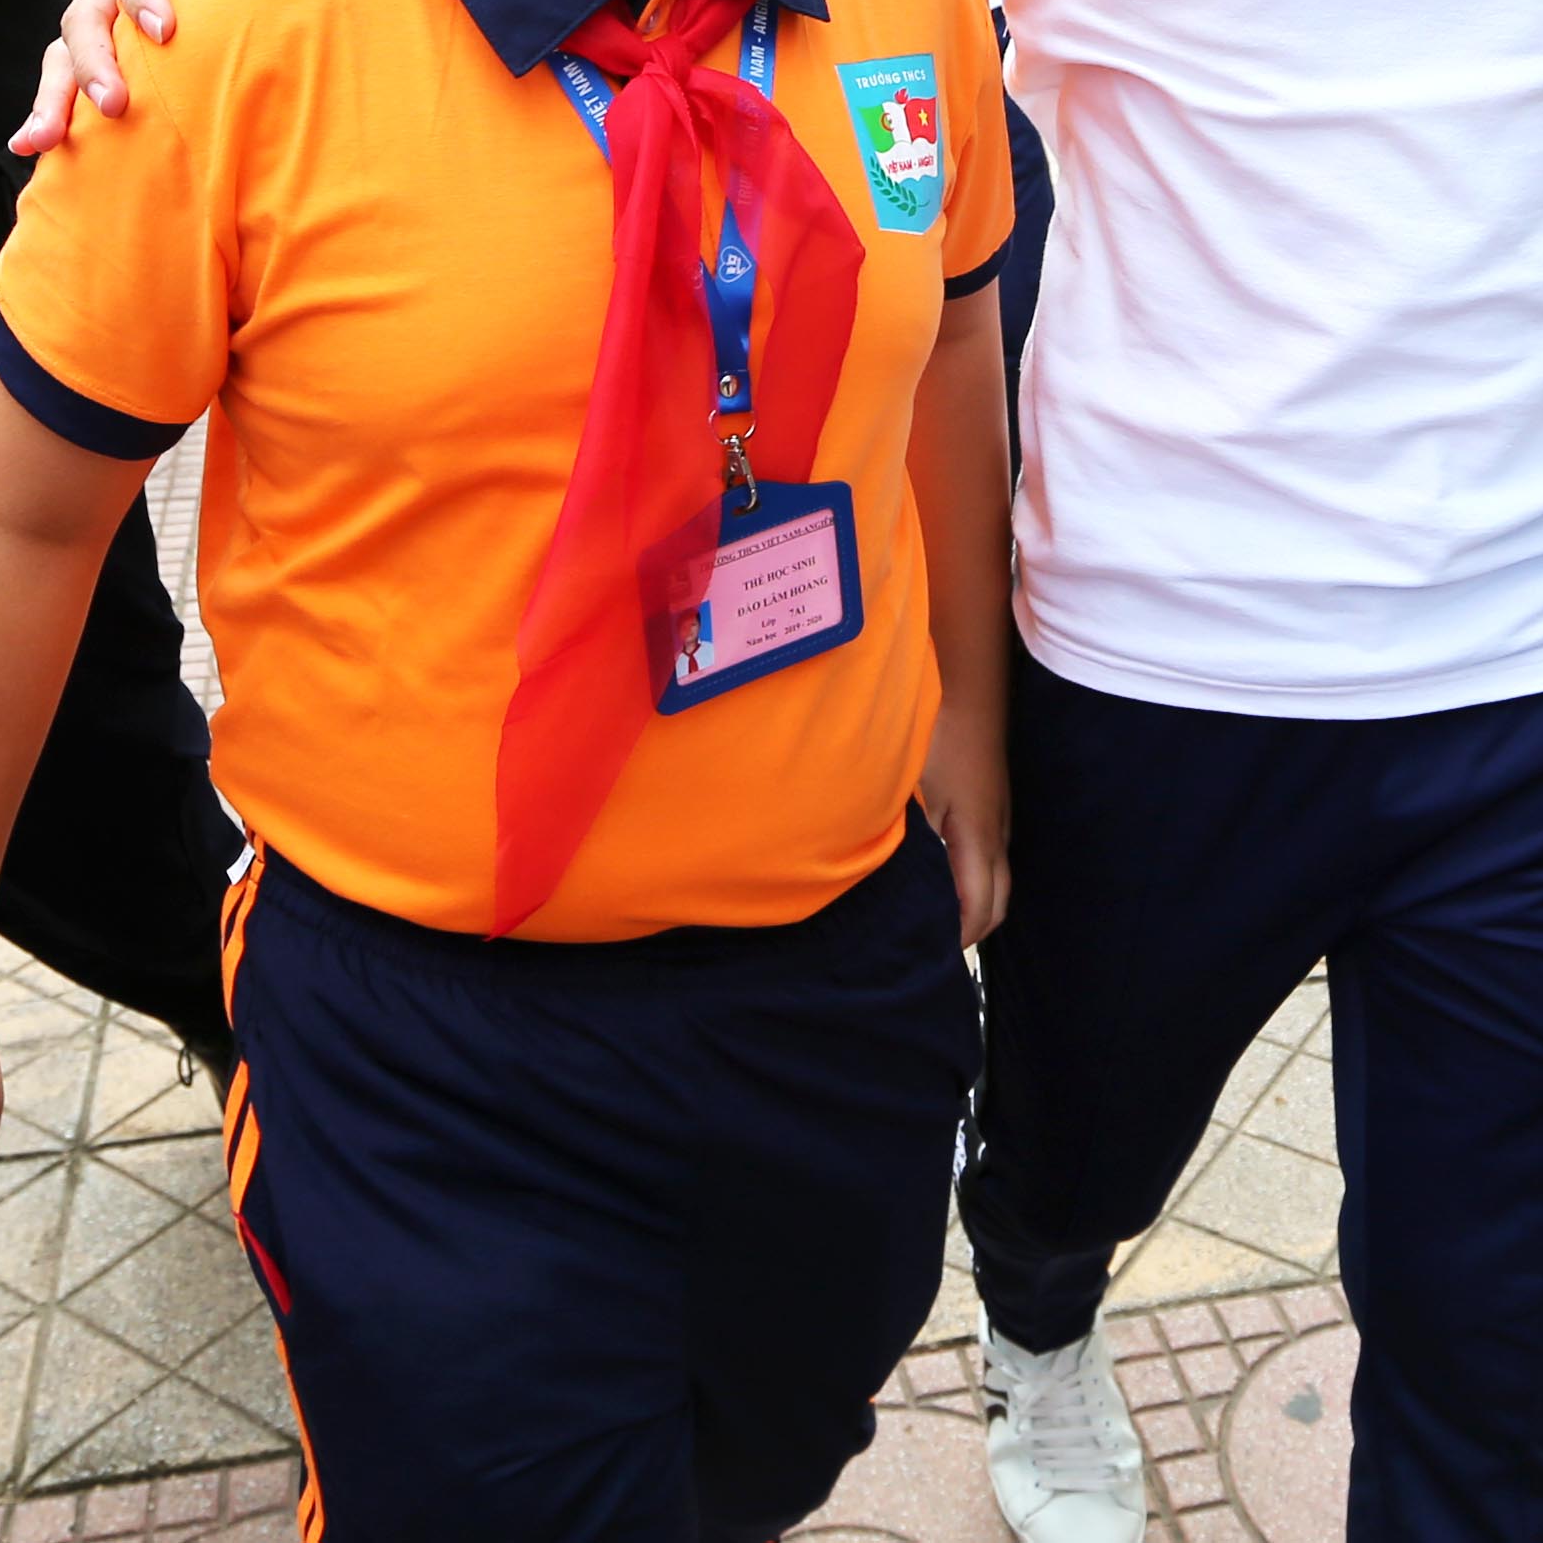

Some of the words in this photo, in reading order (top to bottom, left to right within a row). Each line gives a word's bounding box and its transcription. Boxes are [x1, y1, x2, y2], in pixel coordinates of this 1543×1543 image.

[749, 45, 765, 78] NAM
[563, 61, 593, 97] NAM
[902, 68, 926, 82] THCS
[792, 555, 816, 572] SINH
